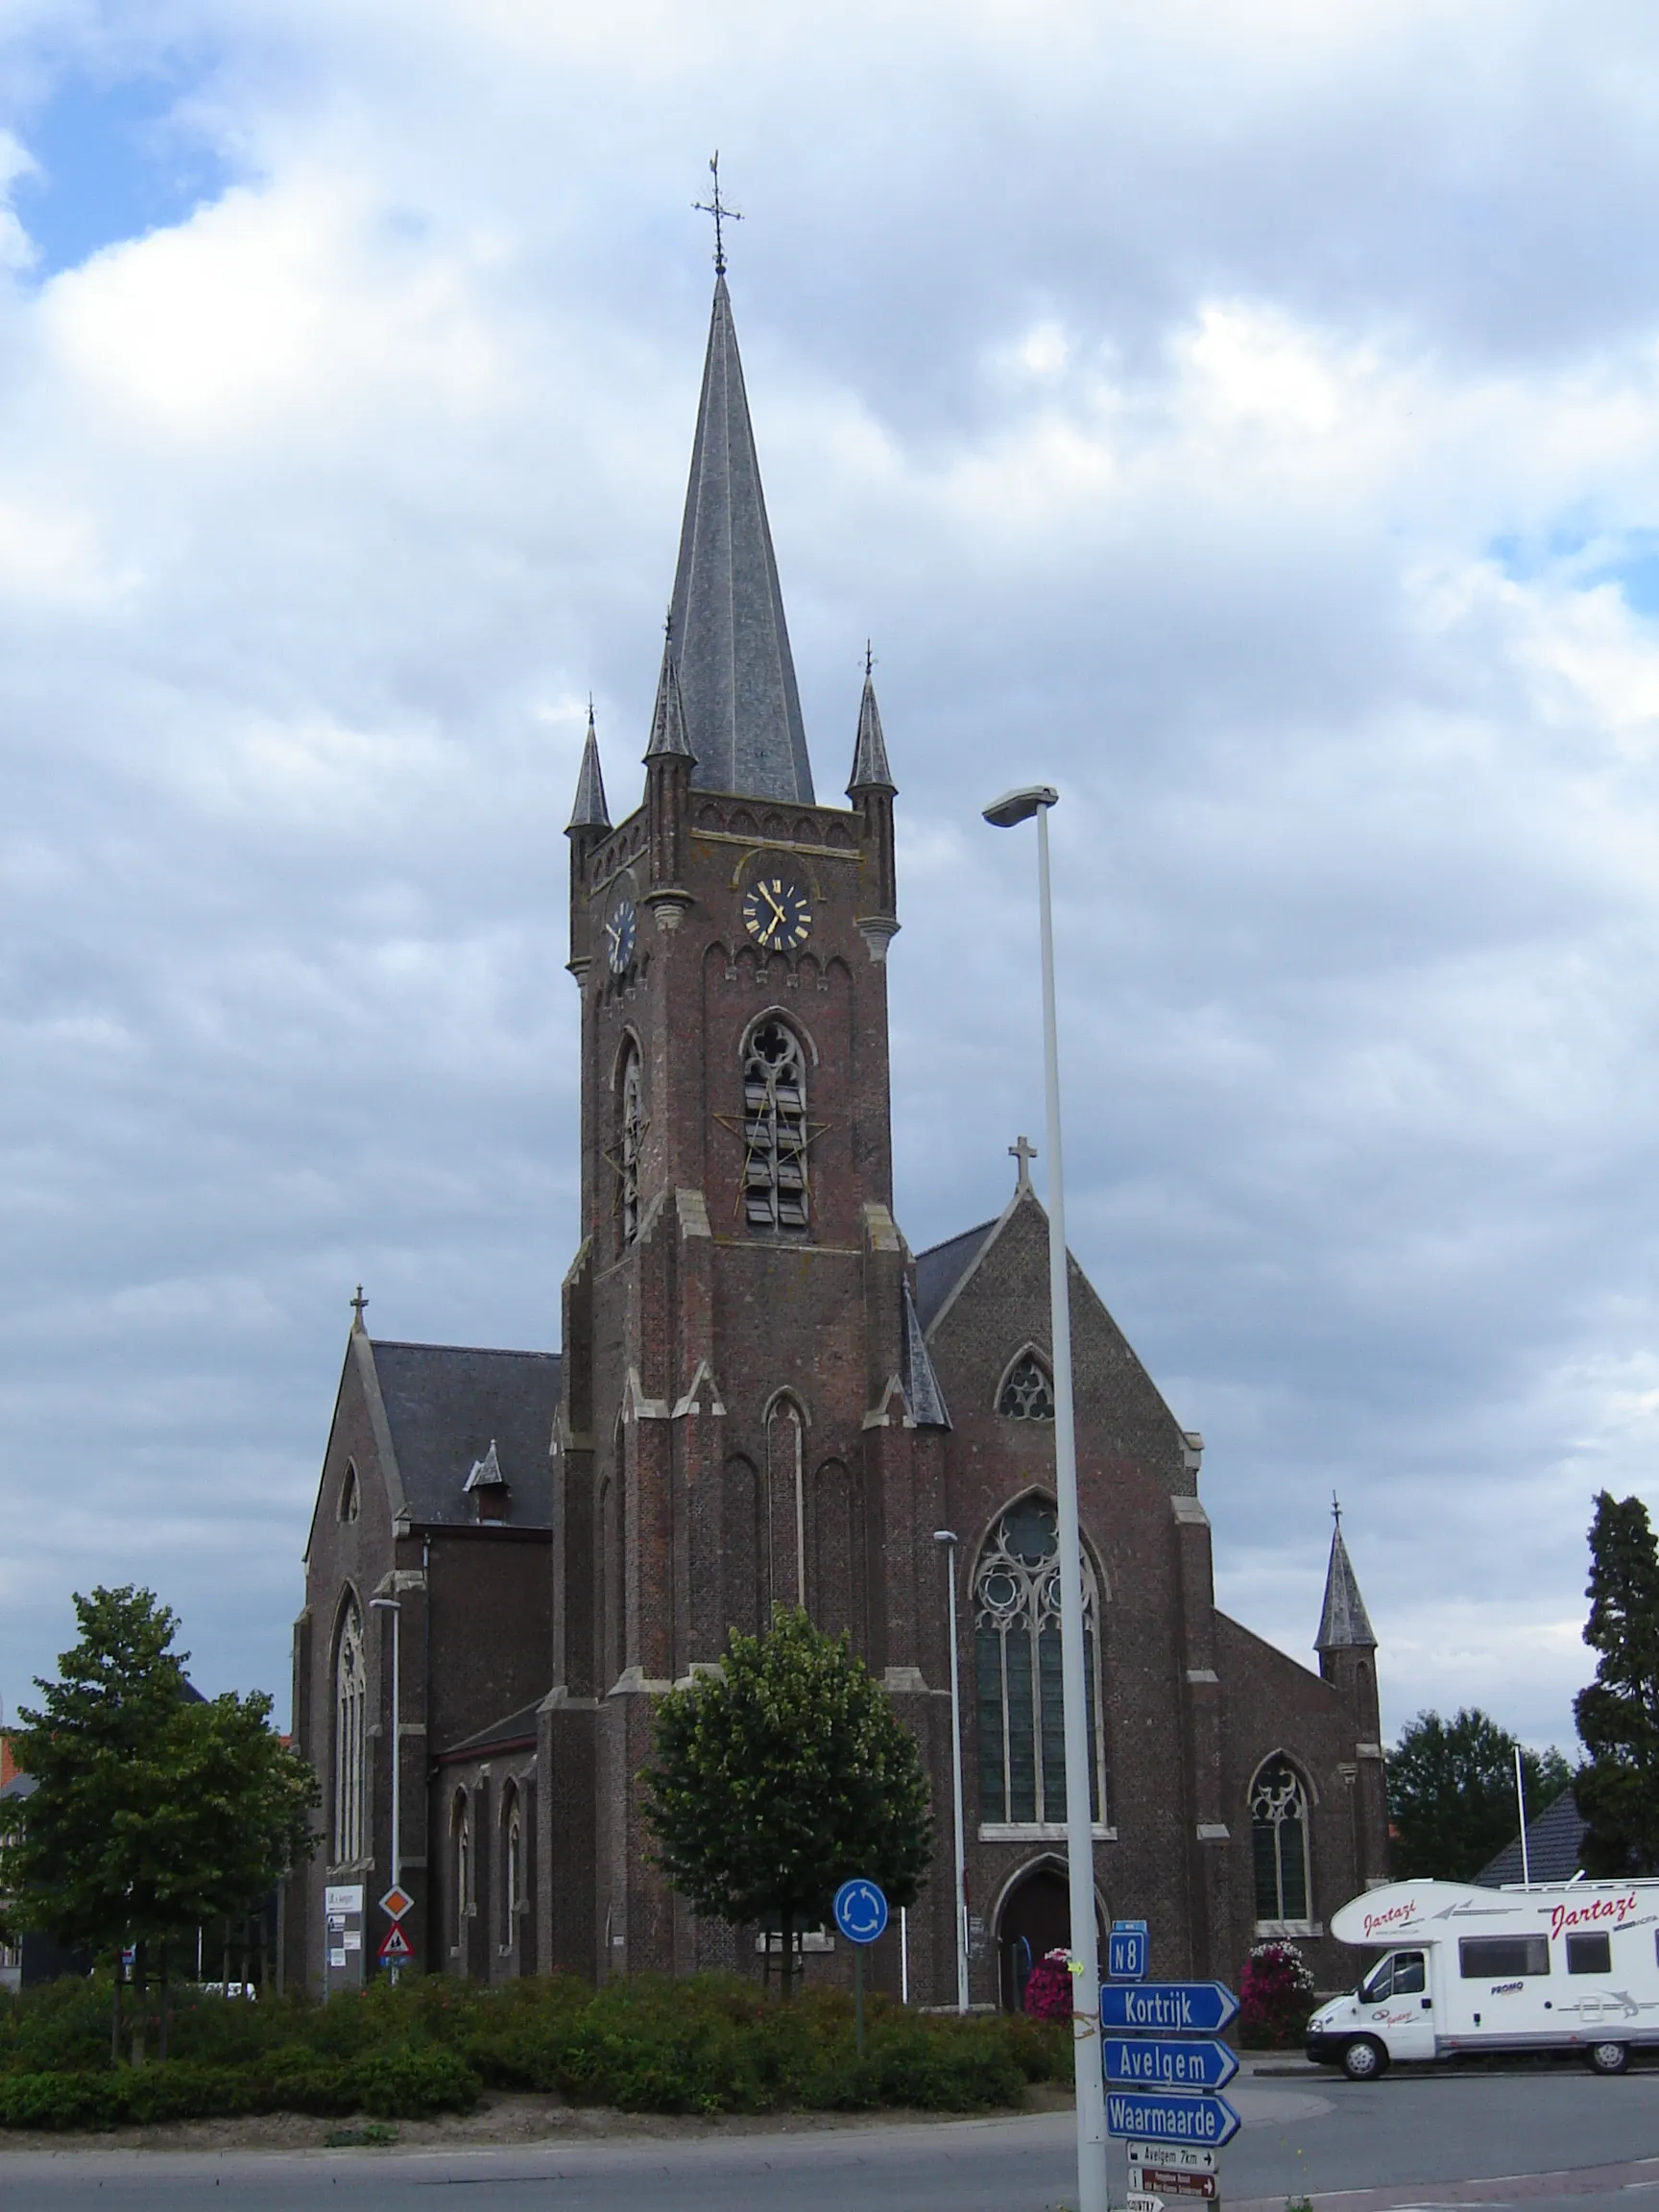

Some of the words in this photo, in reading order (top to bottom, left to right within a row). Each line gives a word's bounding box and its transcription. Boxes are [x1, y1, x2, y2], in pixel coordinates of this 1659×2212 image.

[1363, 1899, 1416, 1937] Jartazi
[1551, 1891, 1638, 1940] Jartazi
[1125, 1991, 1192, 2031] Kortrijk
[1120, 2044, 1205, 2086] Avelgem
[1110, 2098, 1215, 2136] Waarmaarde
[1144, 2146, 1177, 2166] Avelgem
